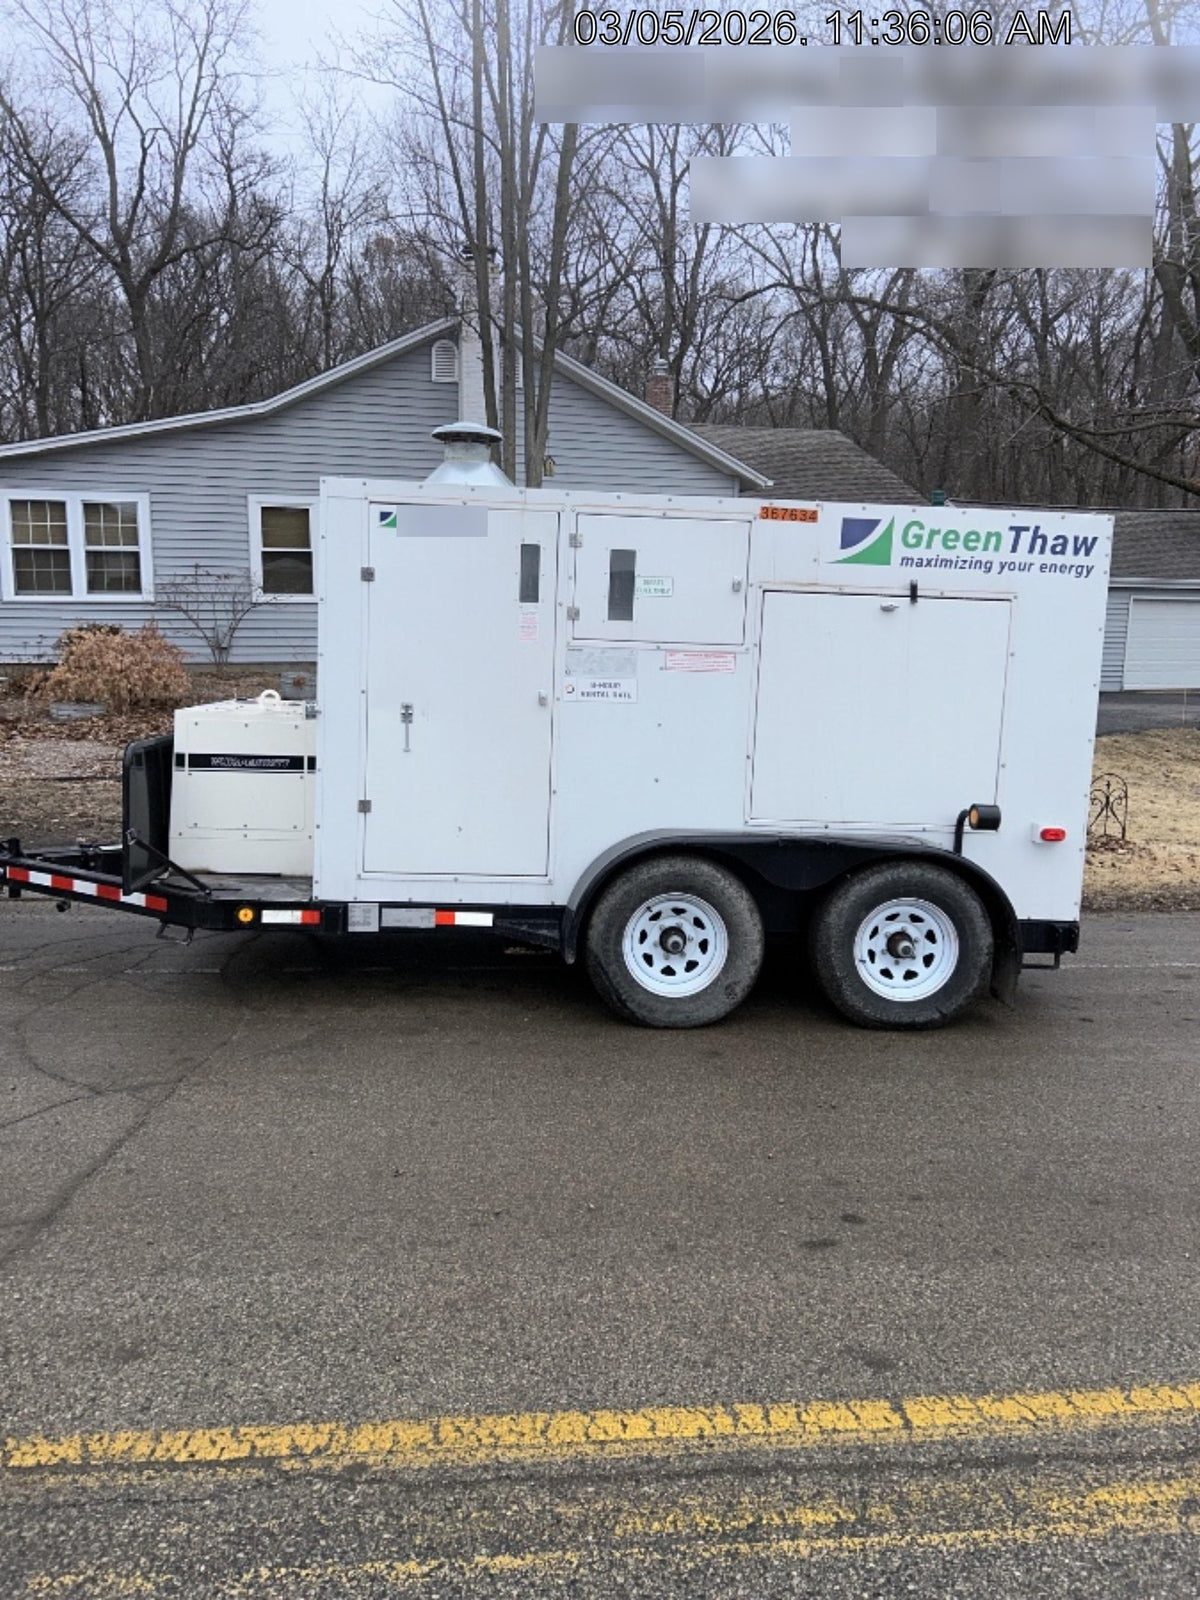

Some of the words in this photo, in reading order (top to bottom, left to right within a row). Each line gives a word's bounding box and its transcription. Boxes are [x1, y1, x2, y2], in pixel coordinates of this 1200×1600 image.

[760, 506, 818, 523] 367634
[900, 553, 994, 574] maximizing
[998, 559, 1035, 575] your
[1039, 562, 1095, 579] energy
